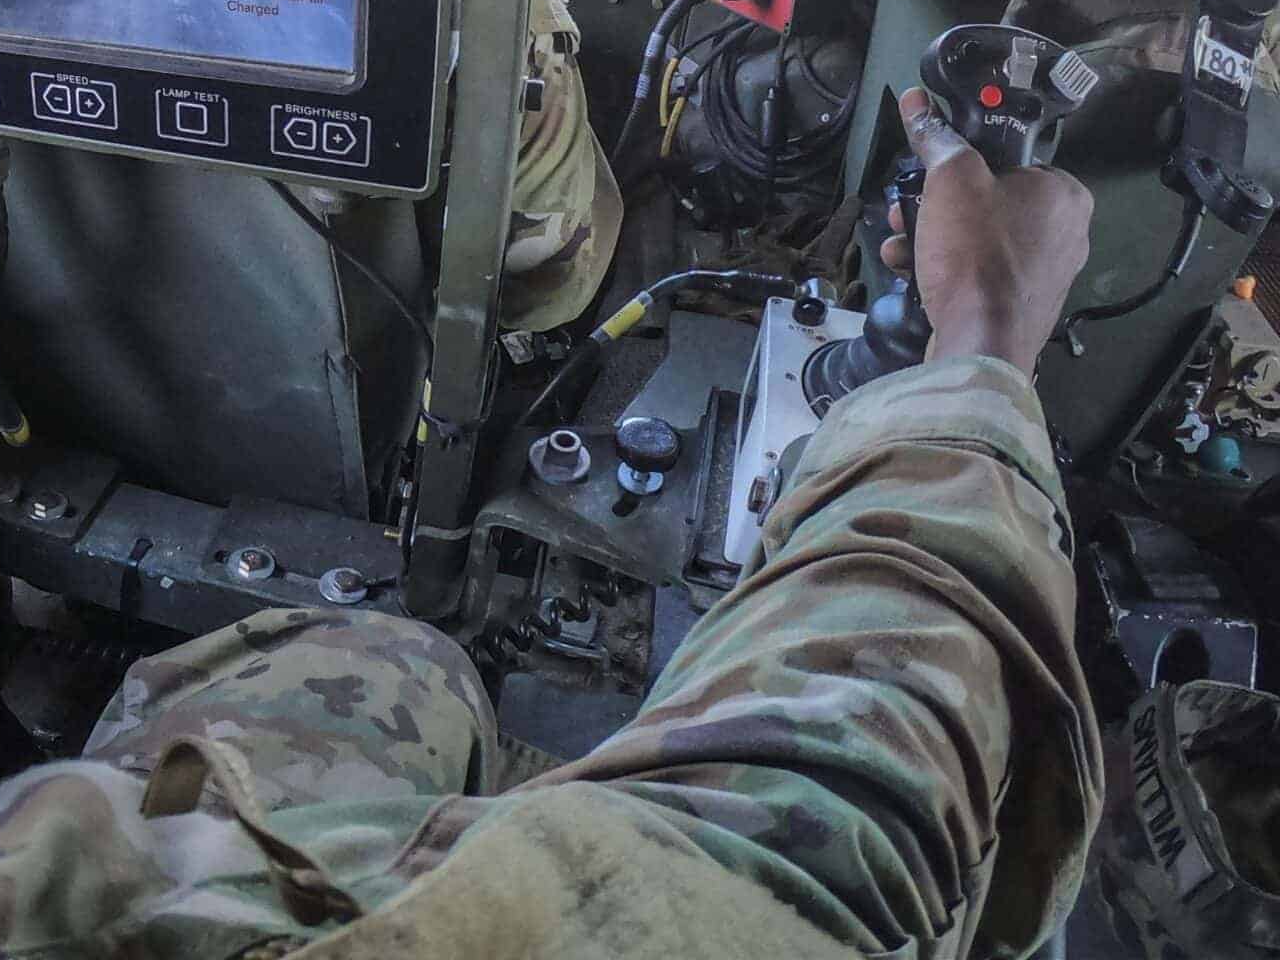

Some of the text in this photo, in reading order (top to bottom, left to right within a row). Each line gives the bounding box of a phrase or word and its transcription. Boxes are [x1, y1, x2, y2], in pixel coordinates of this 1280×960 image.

[227, 0, 279, 16] Charged
[56, 73, 89, 86] SPEED
[162, 88, 220, 103] LAMP TEST
[285, 103, 358, 122] BRIGHTNESS
